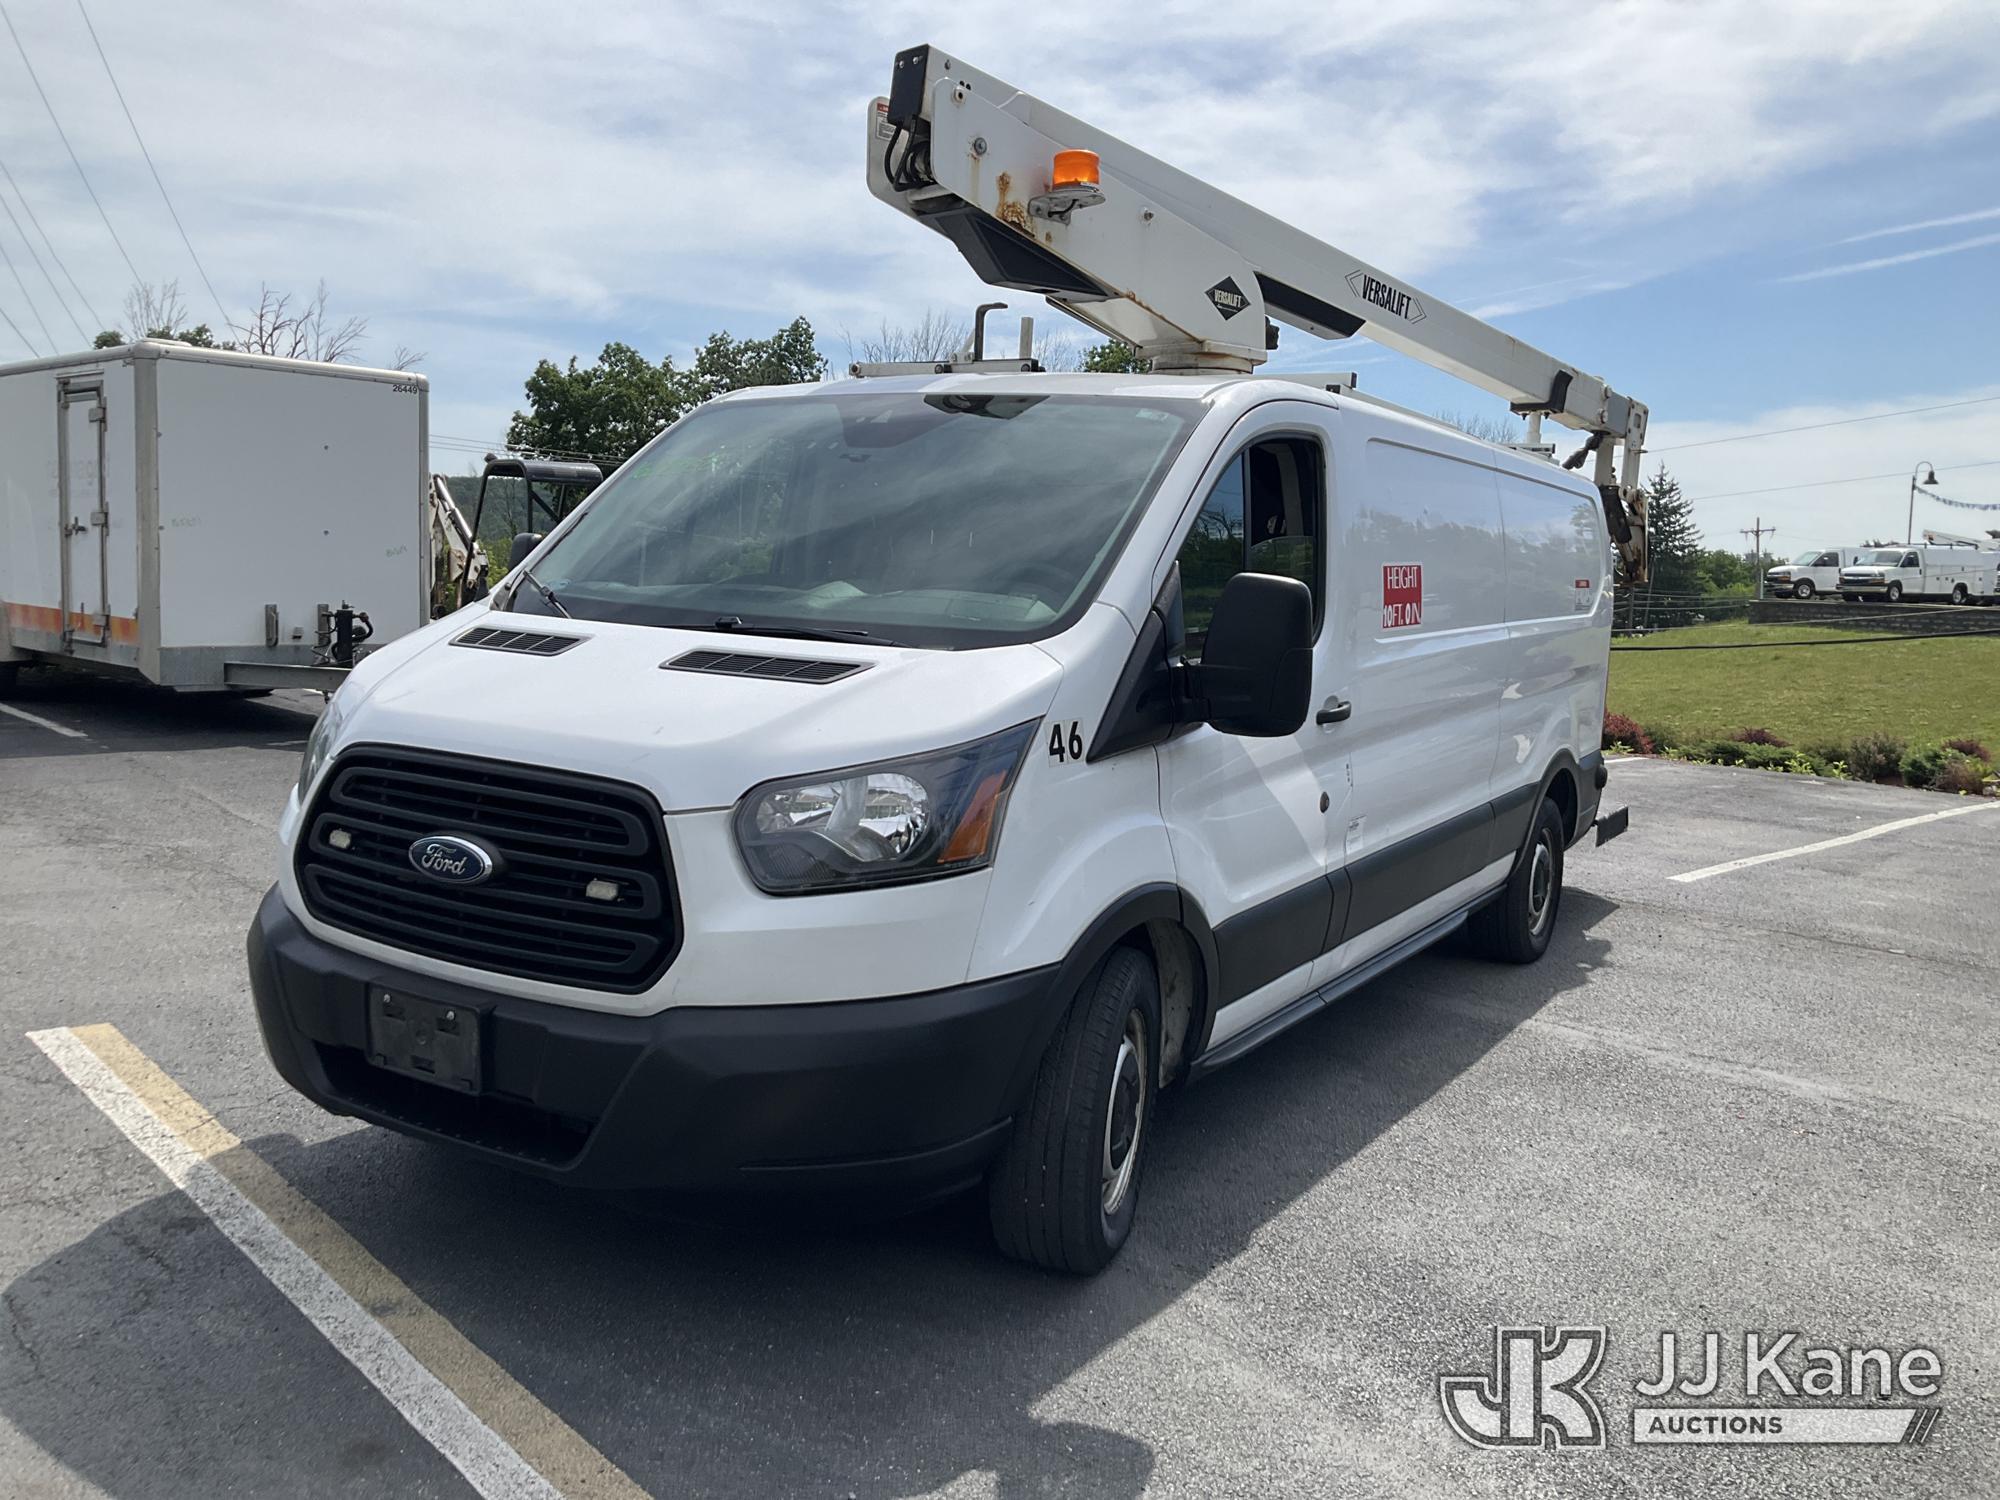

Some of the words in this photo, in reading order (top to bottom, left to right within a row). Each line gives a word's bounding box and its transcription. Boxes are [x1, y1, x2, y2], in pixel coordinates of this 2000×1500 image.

[1214, 289, 1242, 308] VERSALIFT
[1362, 274, 1412, 320] VERSALIFT
[1387, 566, 1418, 589] HEIGHT
[1049, 720, 1083, 763] 46
[421, 843, 468, 875] Ford
